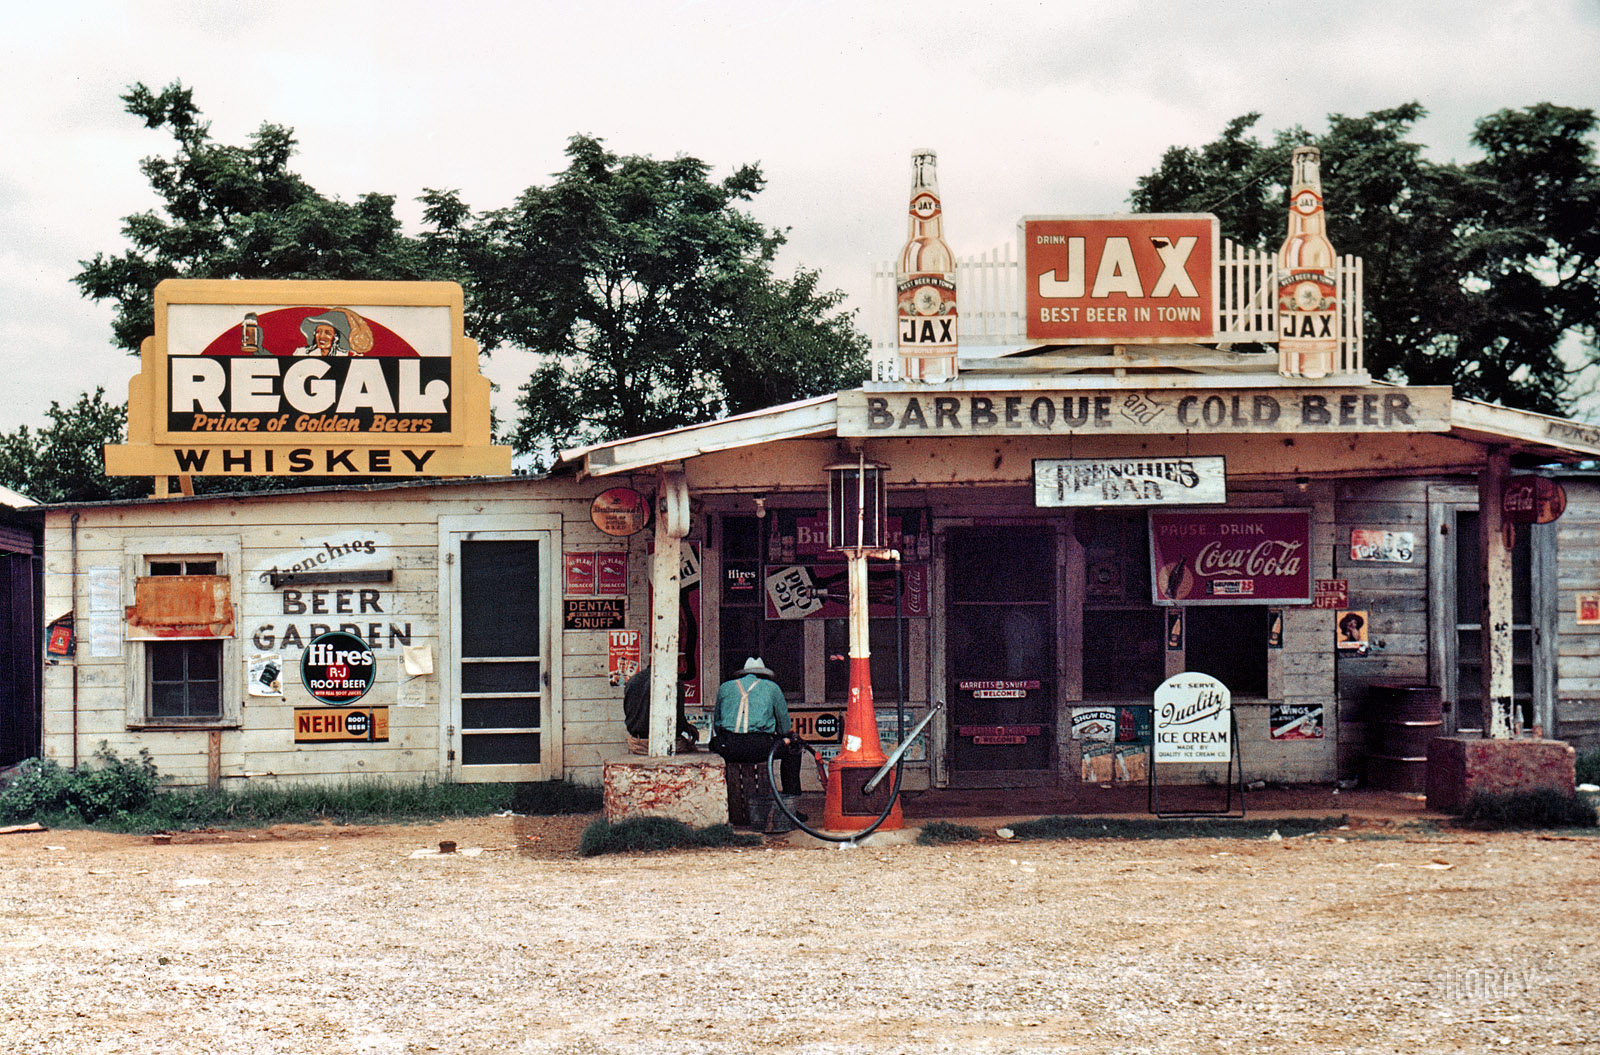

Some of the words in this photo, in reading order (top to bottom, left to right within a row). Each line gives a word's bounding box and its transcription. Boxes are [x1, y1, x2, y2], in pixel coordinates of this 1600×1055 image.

[918, 201, 933, 211] JAX
[1300, 199, 1314, 207] JAX
[1037, 235, 1066, 245] DRINK
[1038, 236, 1199, 298] JAX
[900, 281, 914, 291] BEST
[914, 277, 931, 286] BEER
[931, 277, 938, 285] IN
[1040, 306, 1080, 323] BEST
[1086, 306, 1127, 322] BEER
[1135, 307, 1150, 321] IN
[1157, 306, 1201, 322] TOWN
[903, 319, 952, 343] JAX
[1283, 314, 1332, 338] JAX
[171, 358, 450, 413] REGAL
[866, 395, 1112, 431] BARBEQUE
[1123, 393, 1165, 426] and
[1177, 395, 1281, 428] COLD
[1300, 392, 1415, 427] BEER
[192, 413, 260, 432] Prince
[267, 413, 290, 432] of
[295, 414, 360, 432] Golden
[369, 415, 432, 433] Beers
[174, 449, 437, 473] WHISKEY
[1102, 479, 1164, 500] BAR
[1220, 523, 1265, 535] DRINK
[1195, 540, 1304, 577] Coca-Cola
[728, 569, 756, 579] Hires
[283, 589, 384, 615] BEER
[569, 601, 620, 611] DENTAL
[1314, 598, 1338, 608] UFF
[574, 618, 614, 629] SNUFF
[610, 632, 638, 647] TOP
[308, 643, 374, 666] Hires
[329, 667, 347, 678] R-J
[311, 680, 341, 689] ROOT
[343, 680, 366, 689] BEER
[960, 681, 995, 689] GARRETTS
[1159, 690, 1226, 728] Quality
[1280, 705, 1309, 715] WINGS
[299, 715, 343, 733] NEHI
[1074, 712, 1098, 724] SHOW
[791, 717, 813, 735] HI
[1158, 732, 1180, 744] ICE
[1182, 732, 1227, 744] CREAM
